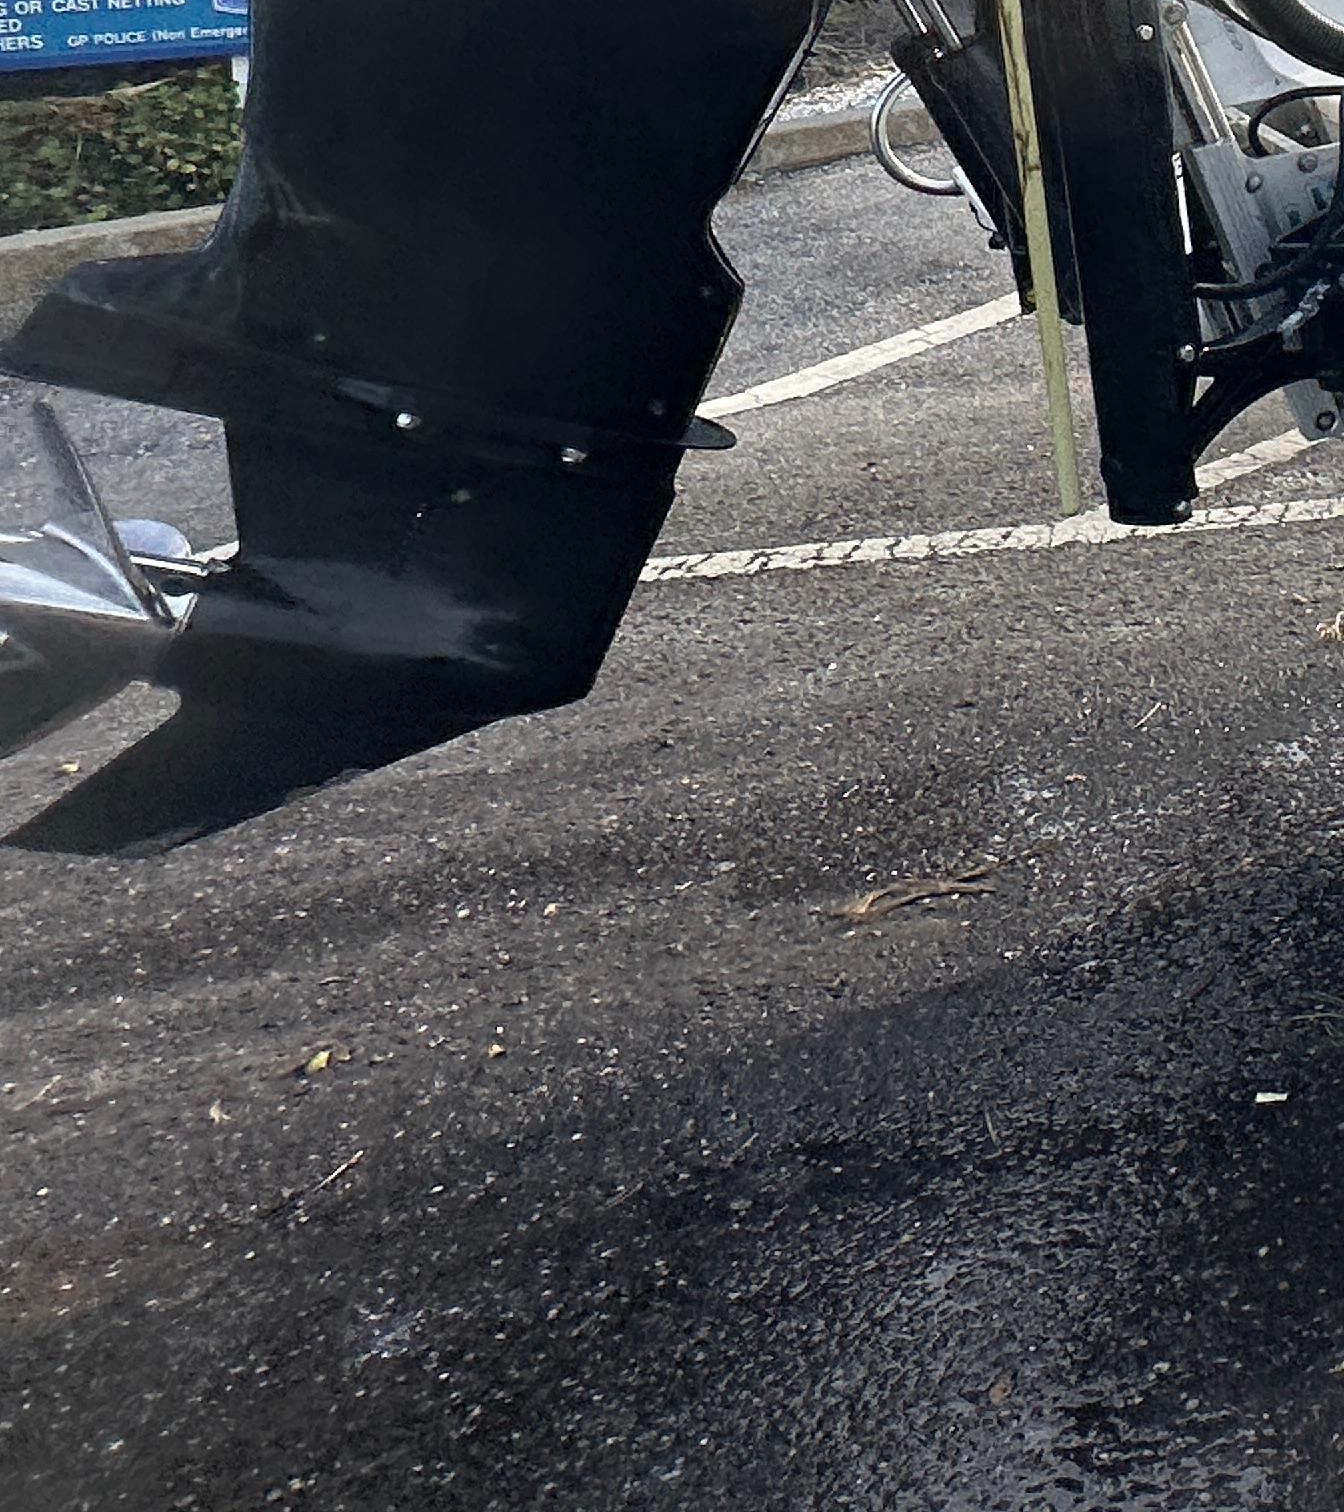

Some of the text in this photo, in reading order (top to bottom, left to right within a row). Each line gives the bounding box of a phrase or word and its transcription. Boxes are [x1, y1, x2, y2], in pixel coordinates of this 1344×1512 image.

[14, 0, 43, 15] OR
[67, 34, 89, 49] GP
[94, 30, 147, 46] POLICE
